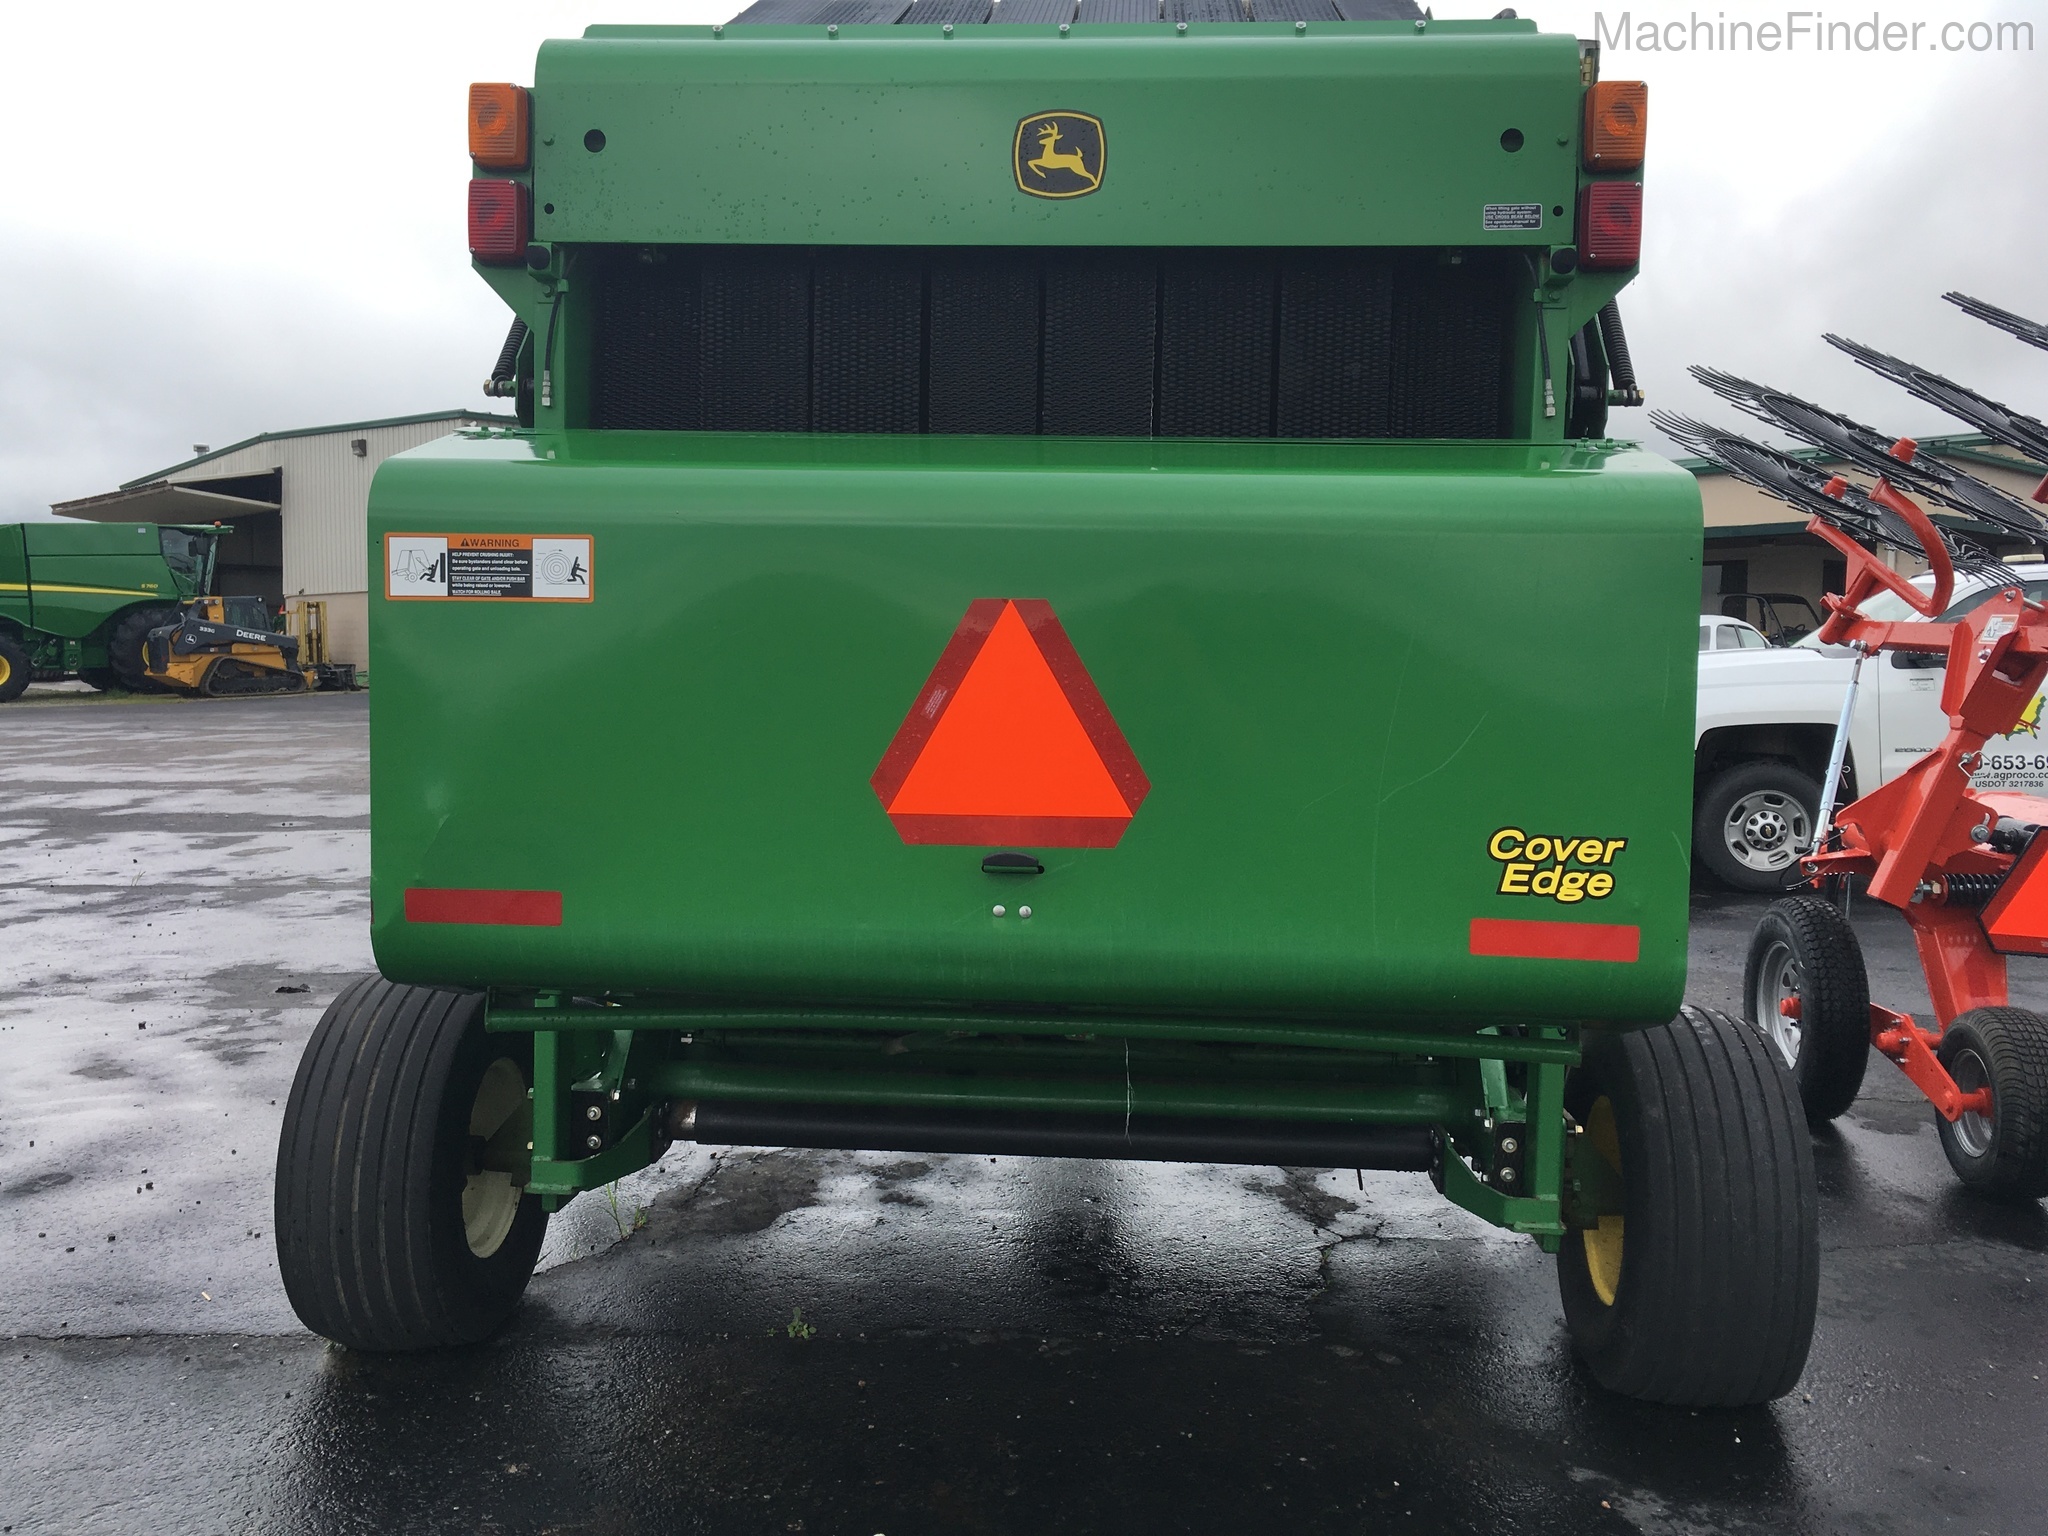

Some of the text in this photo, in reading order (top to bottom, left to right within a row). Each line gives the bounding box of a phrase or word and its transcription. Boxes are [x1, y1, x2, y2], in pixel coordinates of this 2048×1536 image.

[470, 539, 519, 547] WARNING
[236, 629, 266, 642] DEERE
[1978, 755, 2048, 770] -653-6
[1488, 827, 1628, 865] Cover
[1497, 861, 1614, 903] Edge
